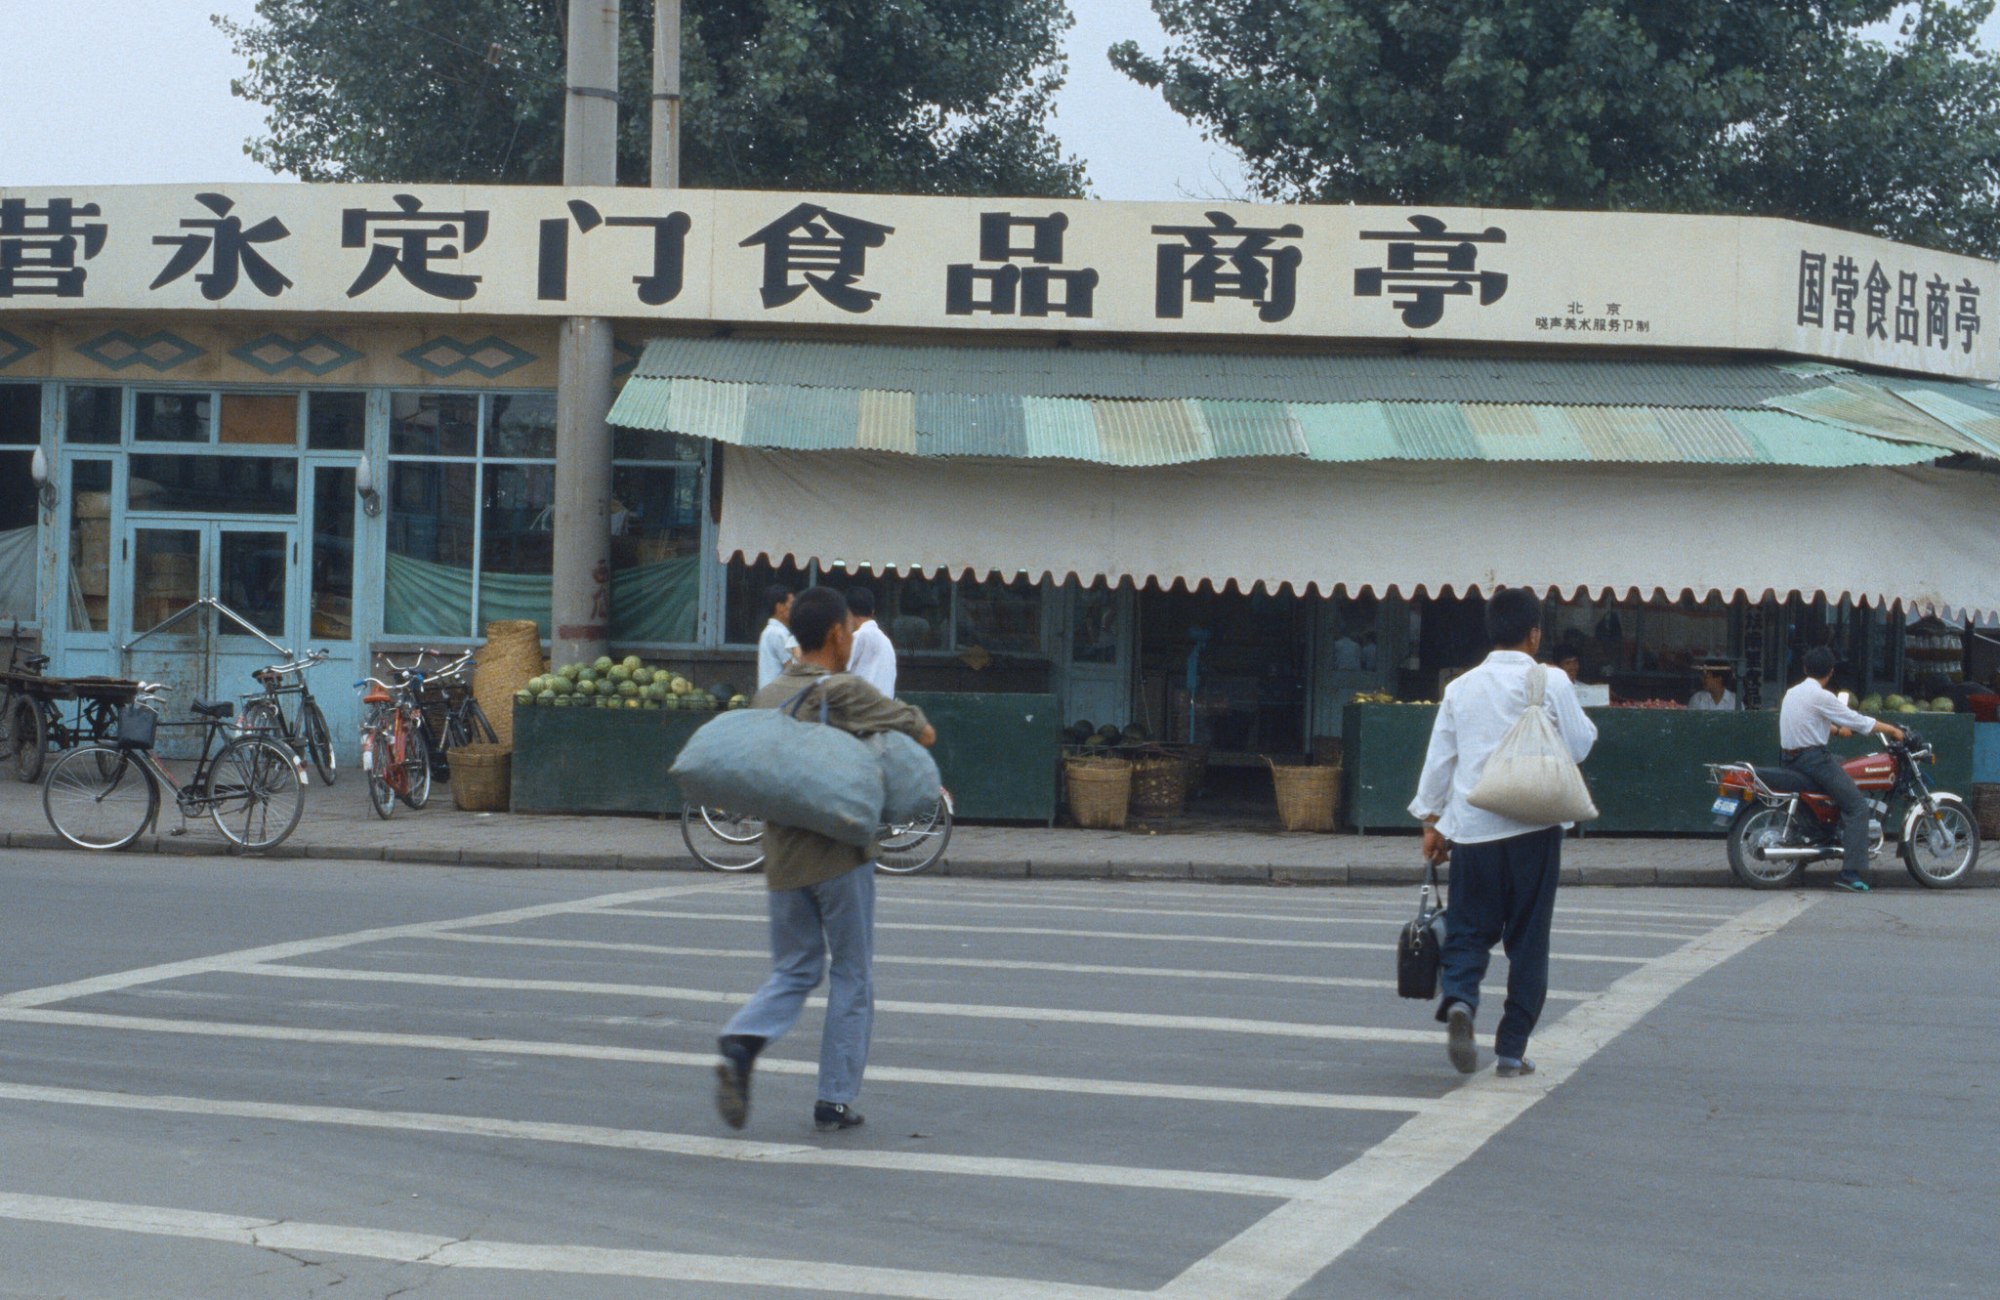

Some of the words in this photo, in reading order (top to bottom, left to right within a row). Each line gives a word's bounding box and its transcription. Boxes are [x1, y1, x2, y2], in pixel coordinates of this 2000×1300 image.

[0, 193, 1507, 329] 营永定门食品商亭
[1567, 301, 1621, 316] 北京
[1797, 250, 1981, 354] 国营食品商亭
